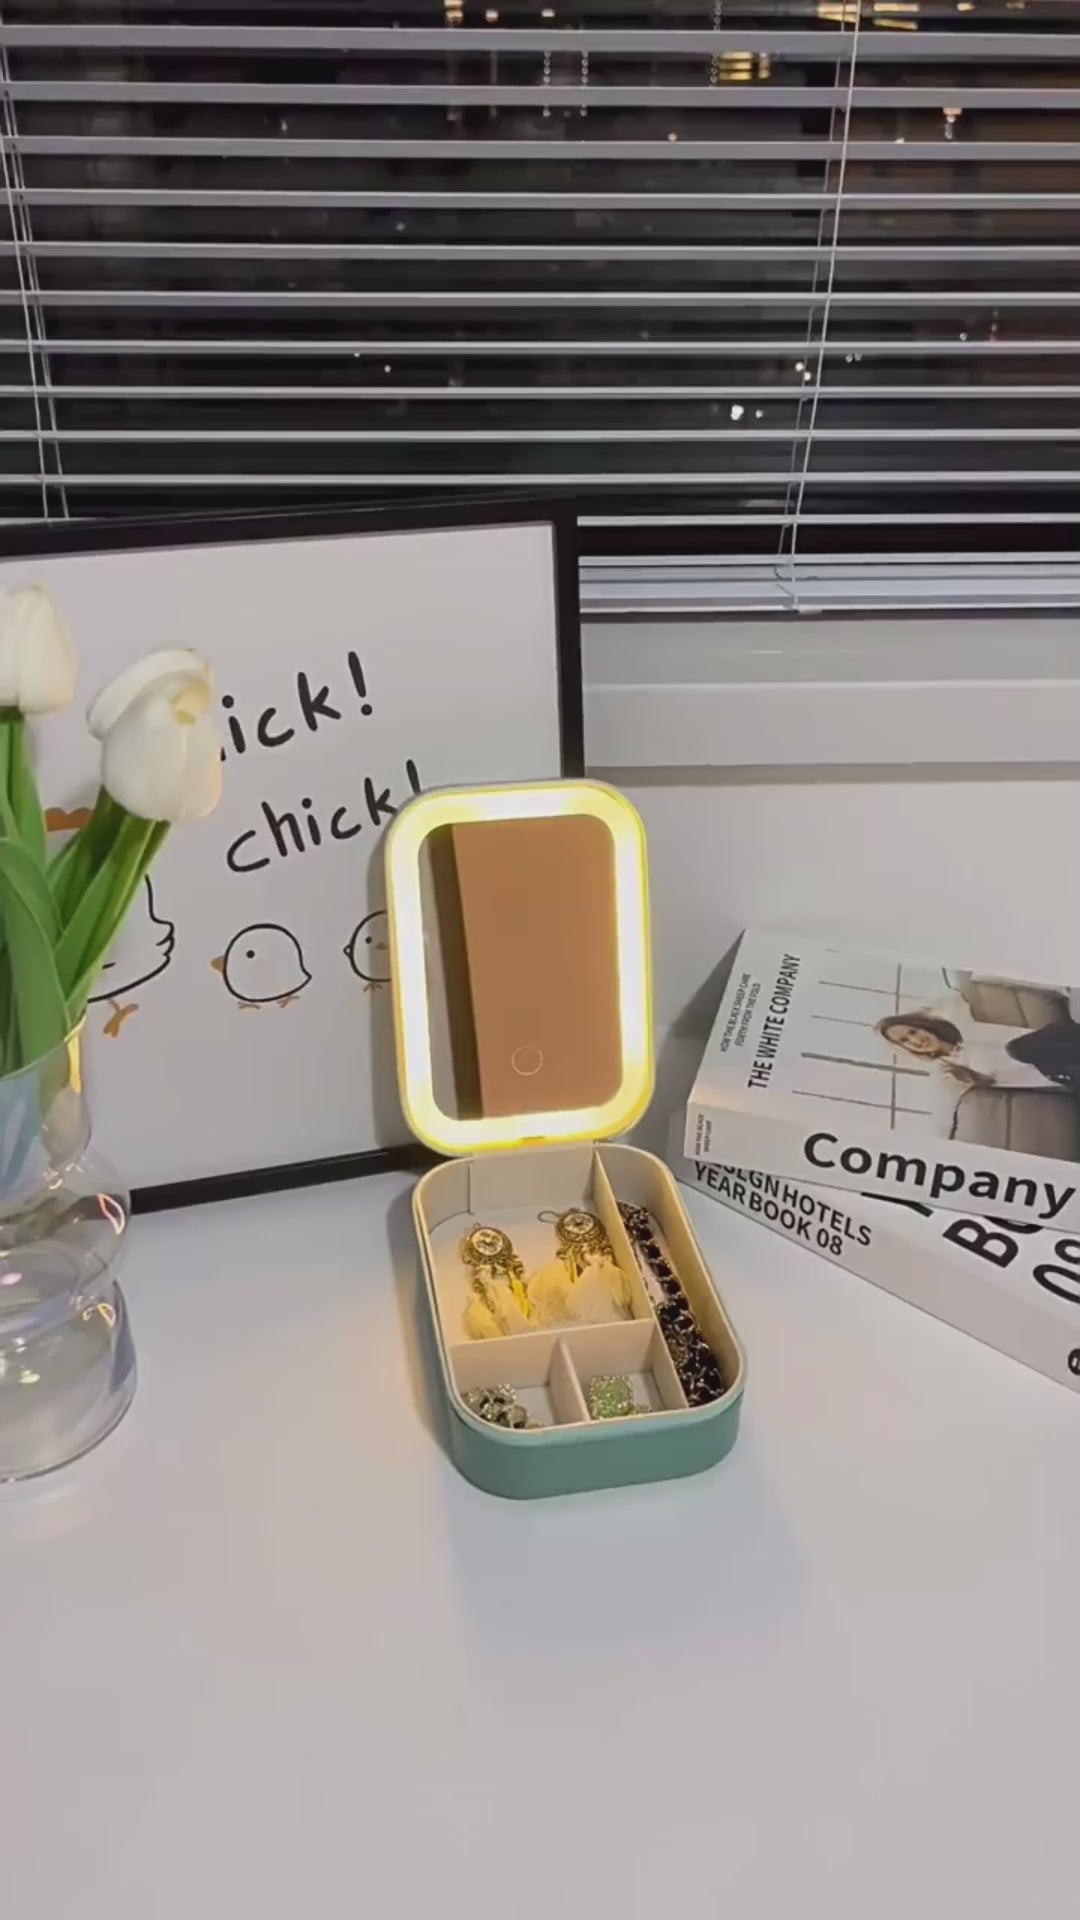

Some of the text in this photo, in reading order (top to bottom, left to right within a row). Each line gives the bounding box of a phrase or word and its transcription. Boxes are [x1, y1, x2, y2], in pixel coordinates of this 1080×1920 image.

[221, 651, 373, 762] ick!
[748, 953, 801, 1089] THE WHITE COMPANY
[695, 1161, 746, 1205] YEAR
[749, 1191, 813, 1241] BOOK
[816, 1228, 843, 1256] 08
[782, 1184, 872, 1246] HOTELS
[804, 1132, 1076, 1219] Company
